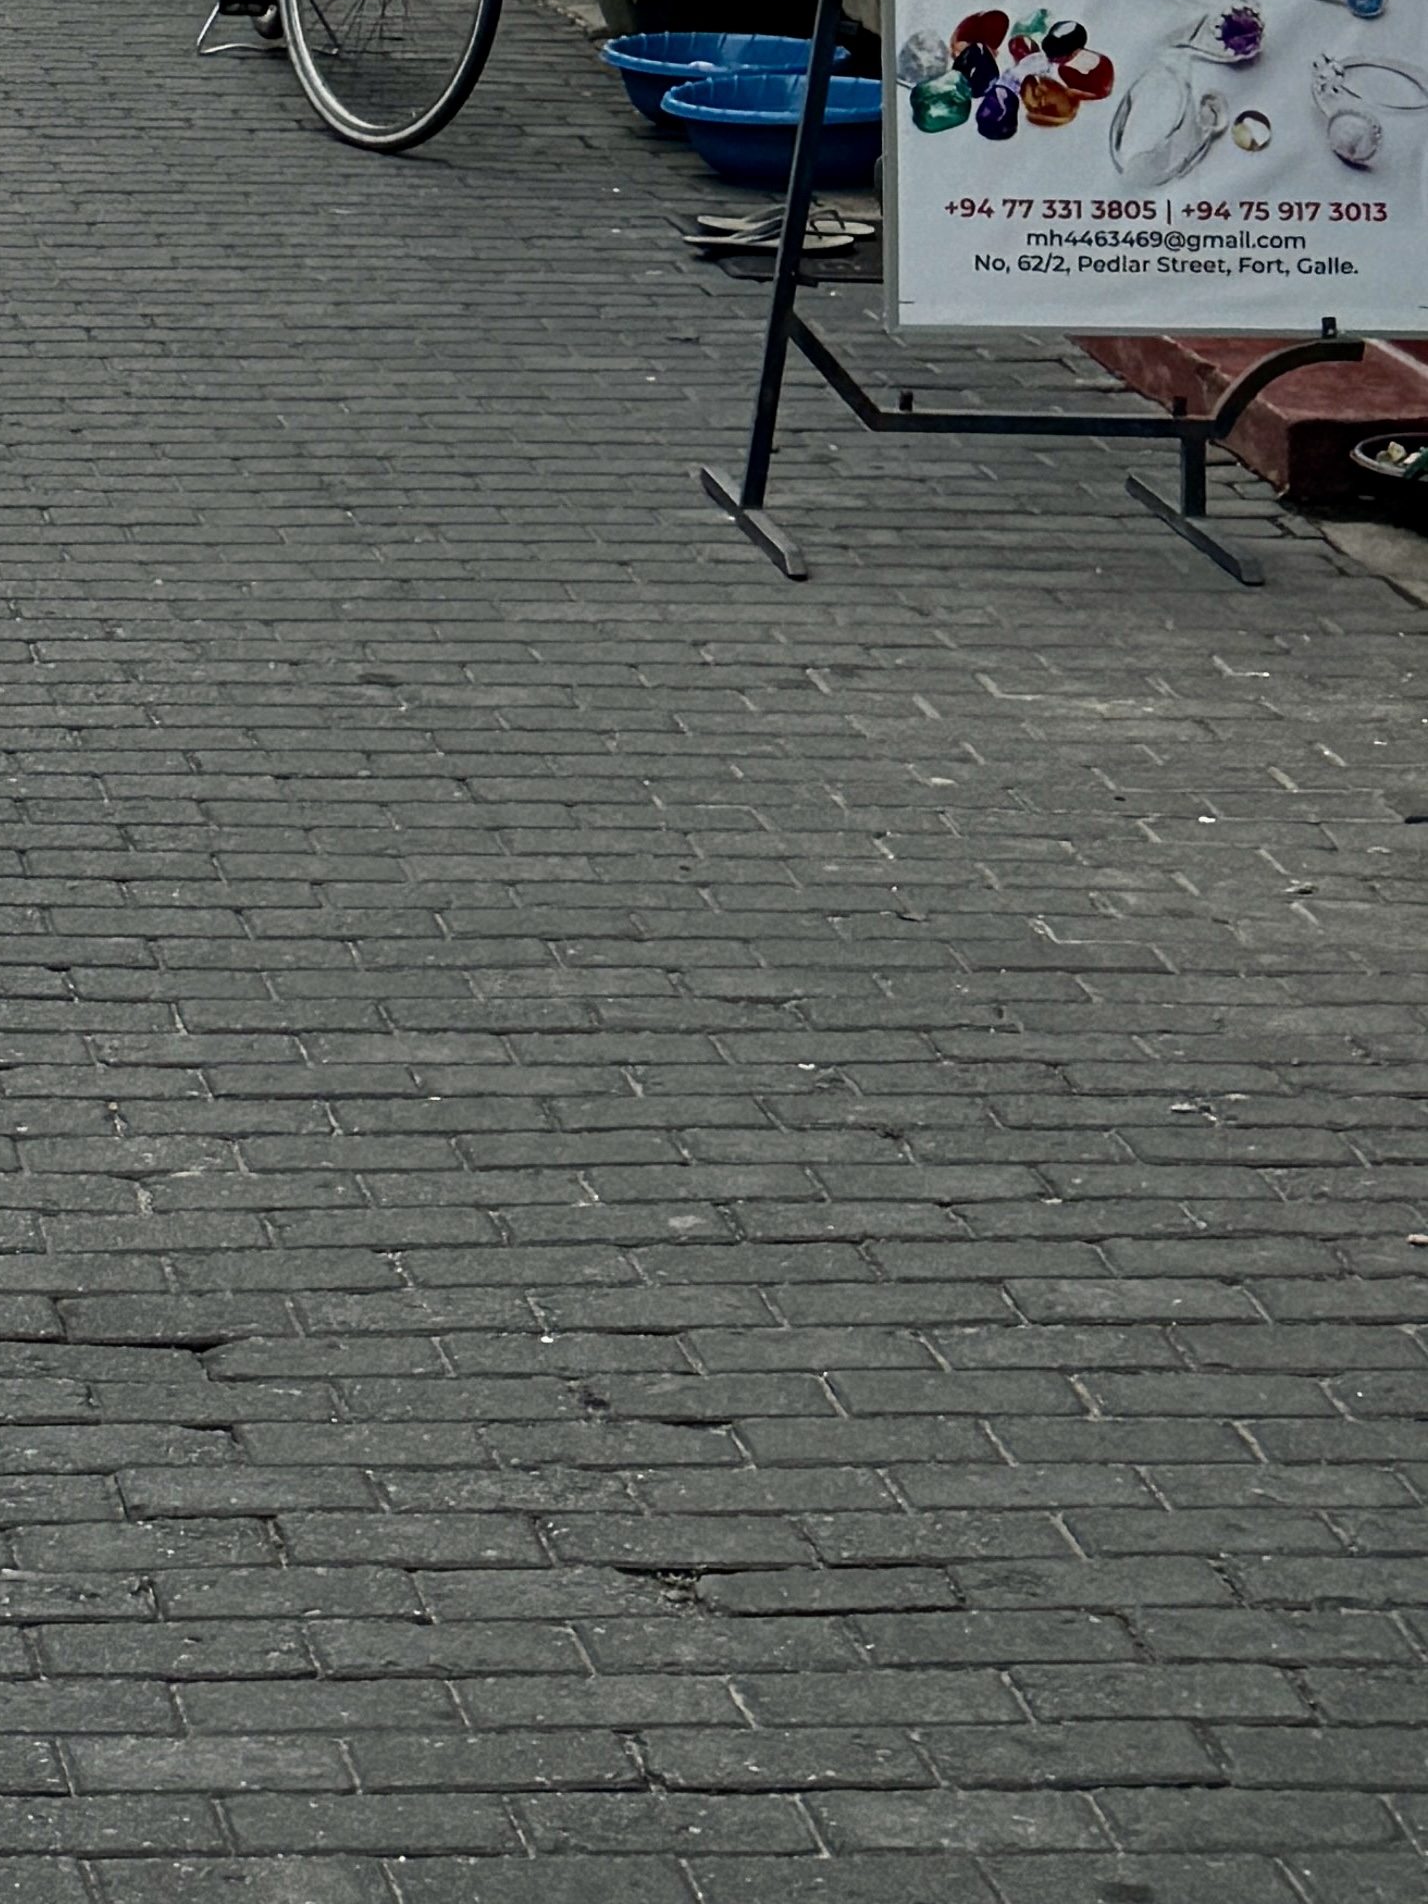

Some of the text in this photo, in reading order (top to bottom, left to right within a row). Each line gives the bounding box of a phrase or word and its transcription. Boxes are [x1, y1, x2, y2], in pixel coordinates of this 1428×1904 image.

[944, 197, 995, 219] +94
[1001, 198, 1034, 219] 77
[1042, 198, 1082, 220] 331
[1090, 199, 1157, 220] 3805
[1181, 200, 1232, 221] +94
[1239, 201, 1270, 221] 75
[1277, 201, 1322, 222] 917
[1328, 201, 1388, 223] 3013
[1026, 228, 1306, 252] mh4463469@gmail.com
[1017, 252, 1071, 276] 62/2,
[1078, 254, 1150, 274] Pedlar
[1156, 256, 1232, 277] Street,
[1238, 257, 1290, 277] Fort,
[1296, 256, 1359, 276] Galle.
